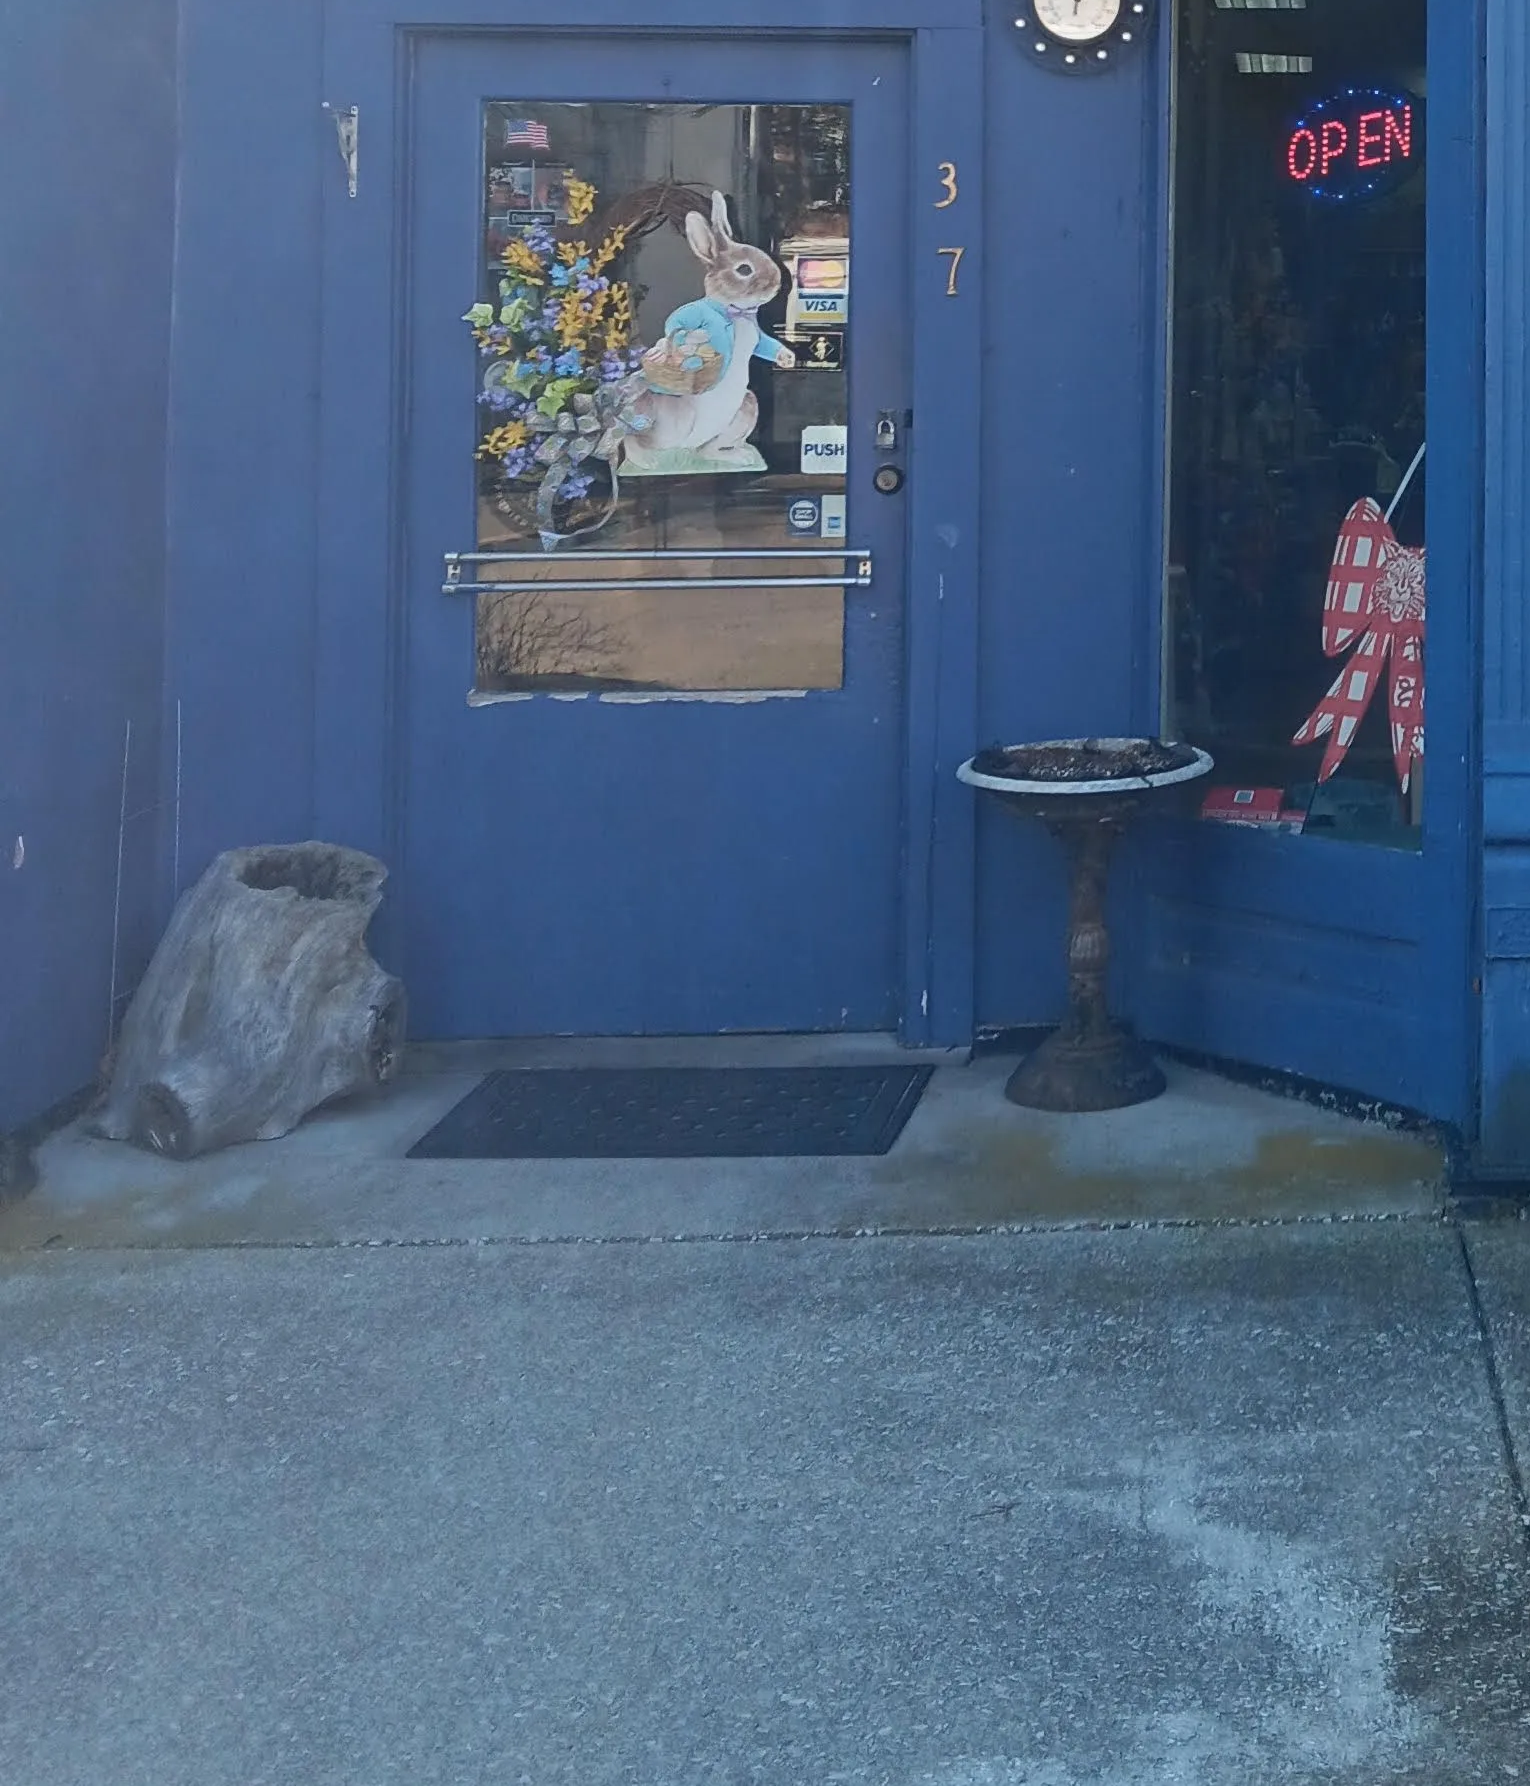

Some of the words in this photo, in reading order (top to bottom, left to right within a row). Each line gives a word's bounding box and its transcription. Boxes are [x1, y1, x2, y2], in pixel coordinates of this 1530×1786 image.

[1288, 105, 1411, 179] OPEN
[804, 299, 839, 312] VISA
[804, 443, 844, 457] PUSH
